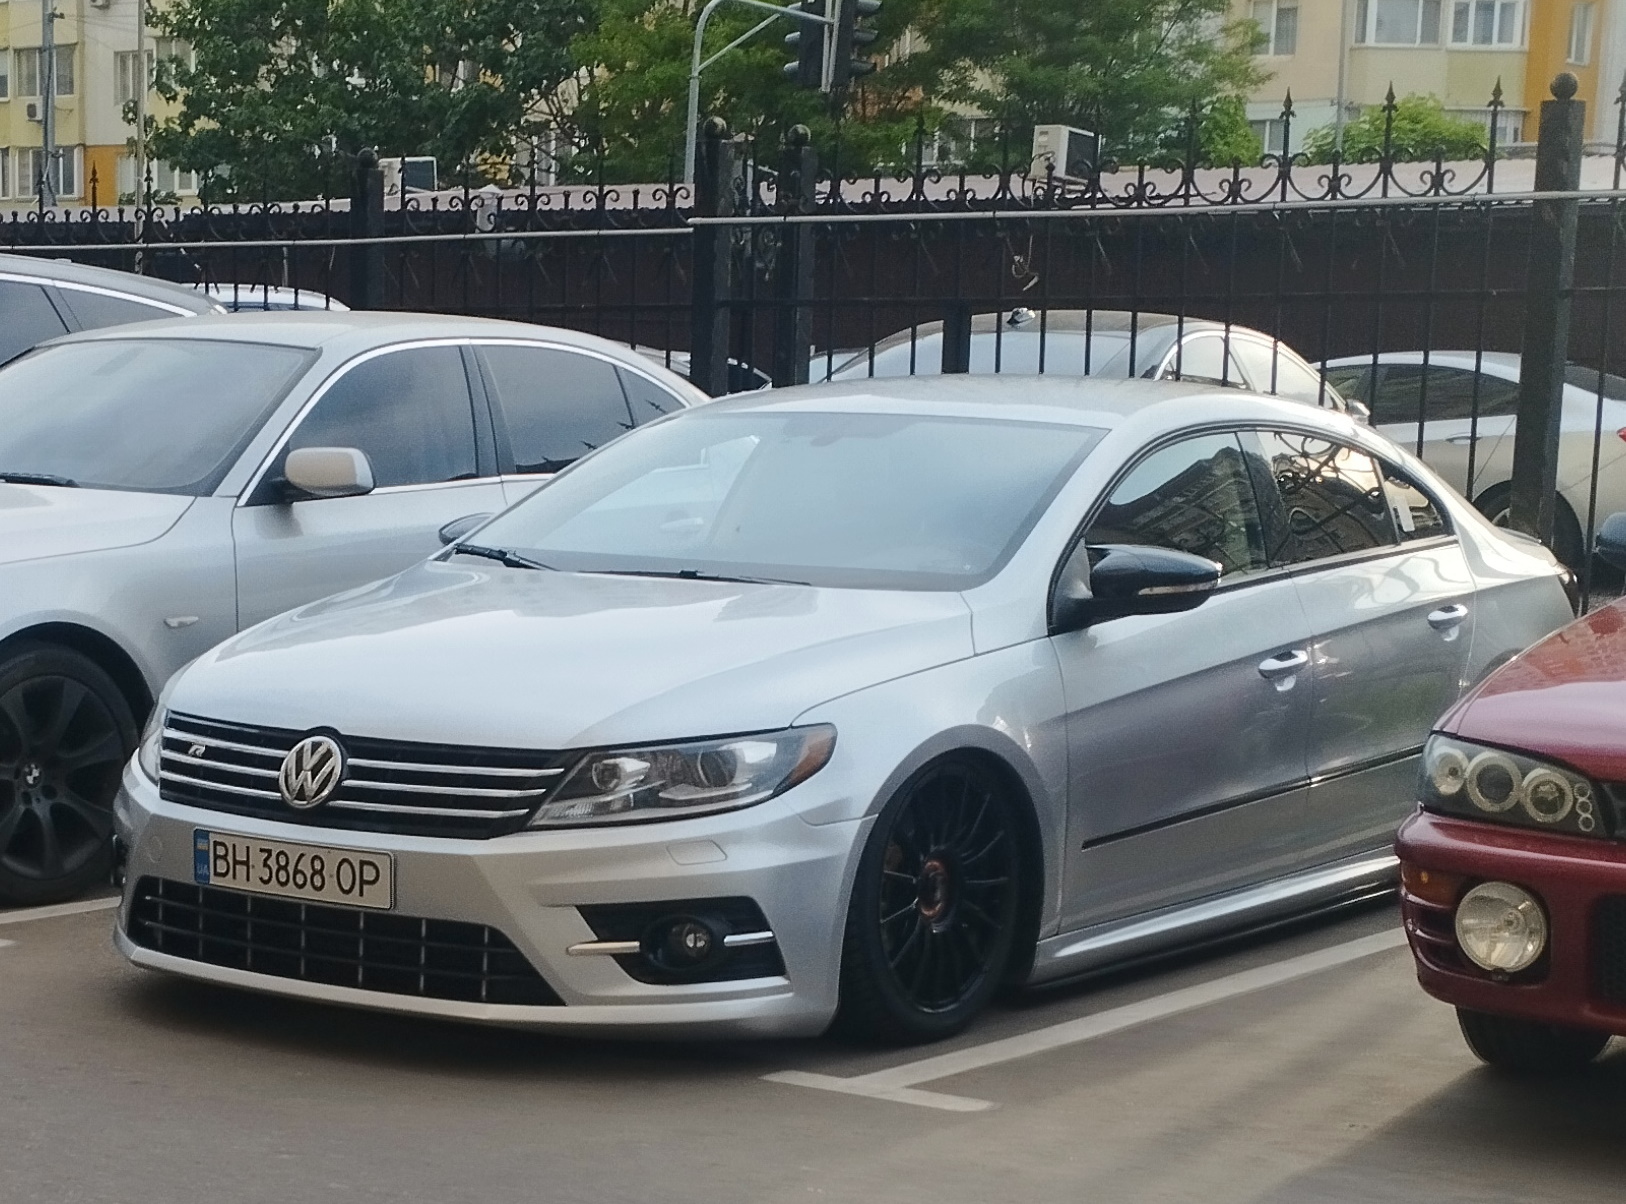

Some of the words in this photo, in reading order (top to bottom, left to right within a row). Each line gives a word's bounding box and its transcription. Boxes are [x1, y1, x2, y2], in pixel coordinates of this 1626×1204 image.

[212, 840, 250, 883] BH
[258, 847, 326, 891] 3868
[335, 857, 381, 897] OP
